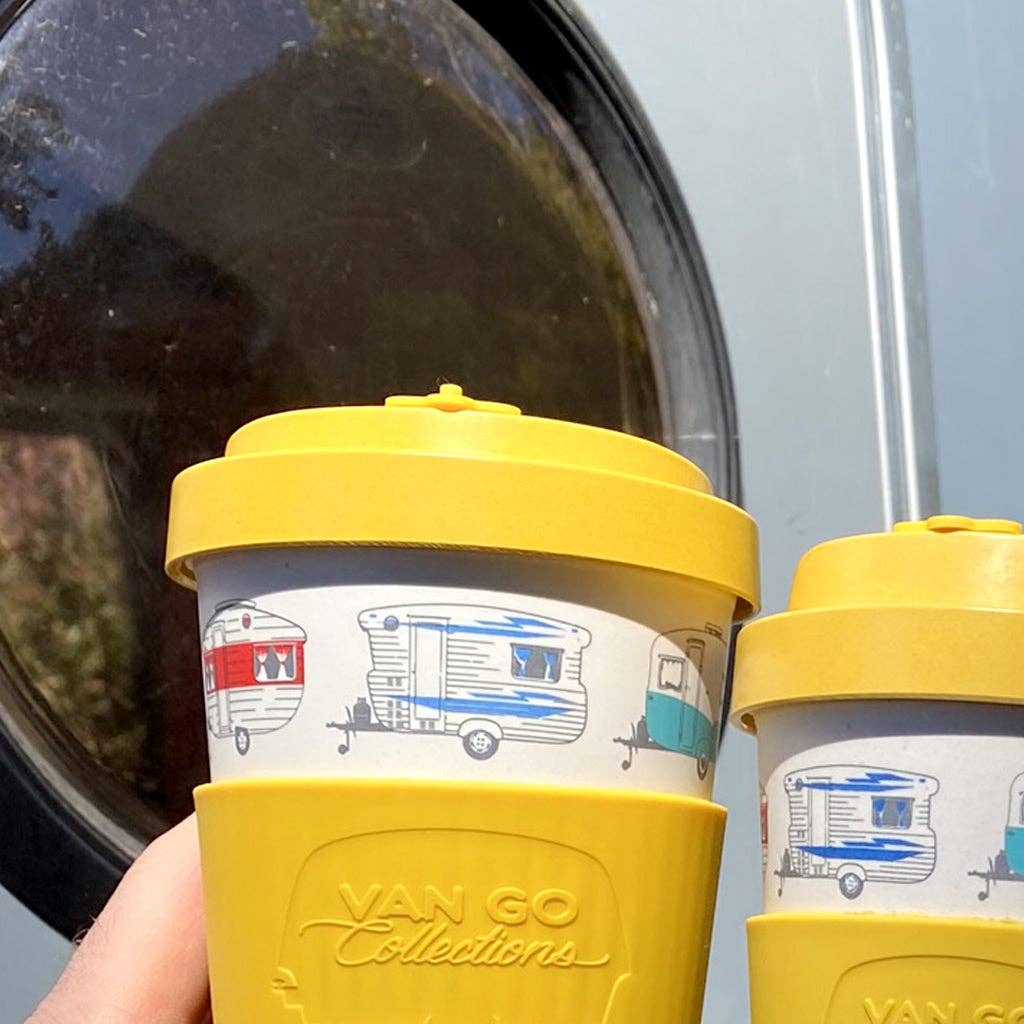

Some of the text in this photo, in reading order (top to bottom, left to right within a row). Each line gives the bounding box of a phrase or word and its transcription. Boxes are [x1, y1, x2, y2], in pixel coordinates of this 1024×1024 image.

[338, 882, 580, 928] VAN GO
[298, 918, 611, 968] Collections
